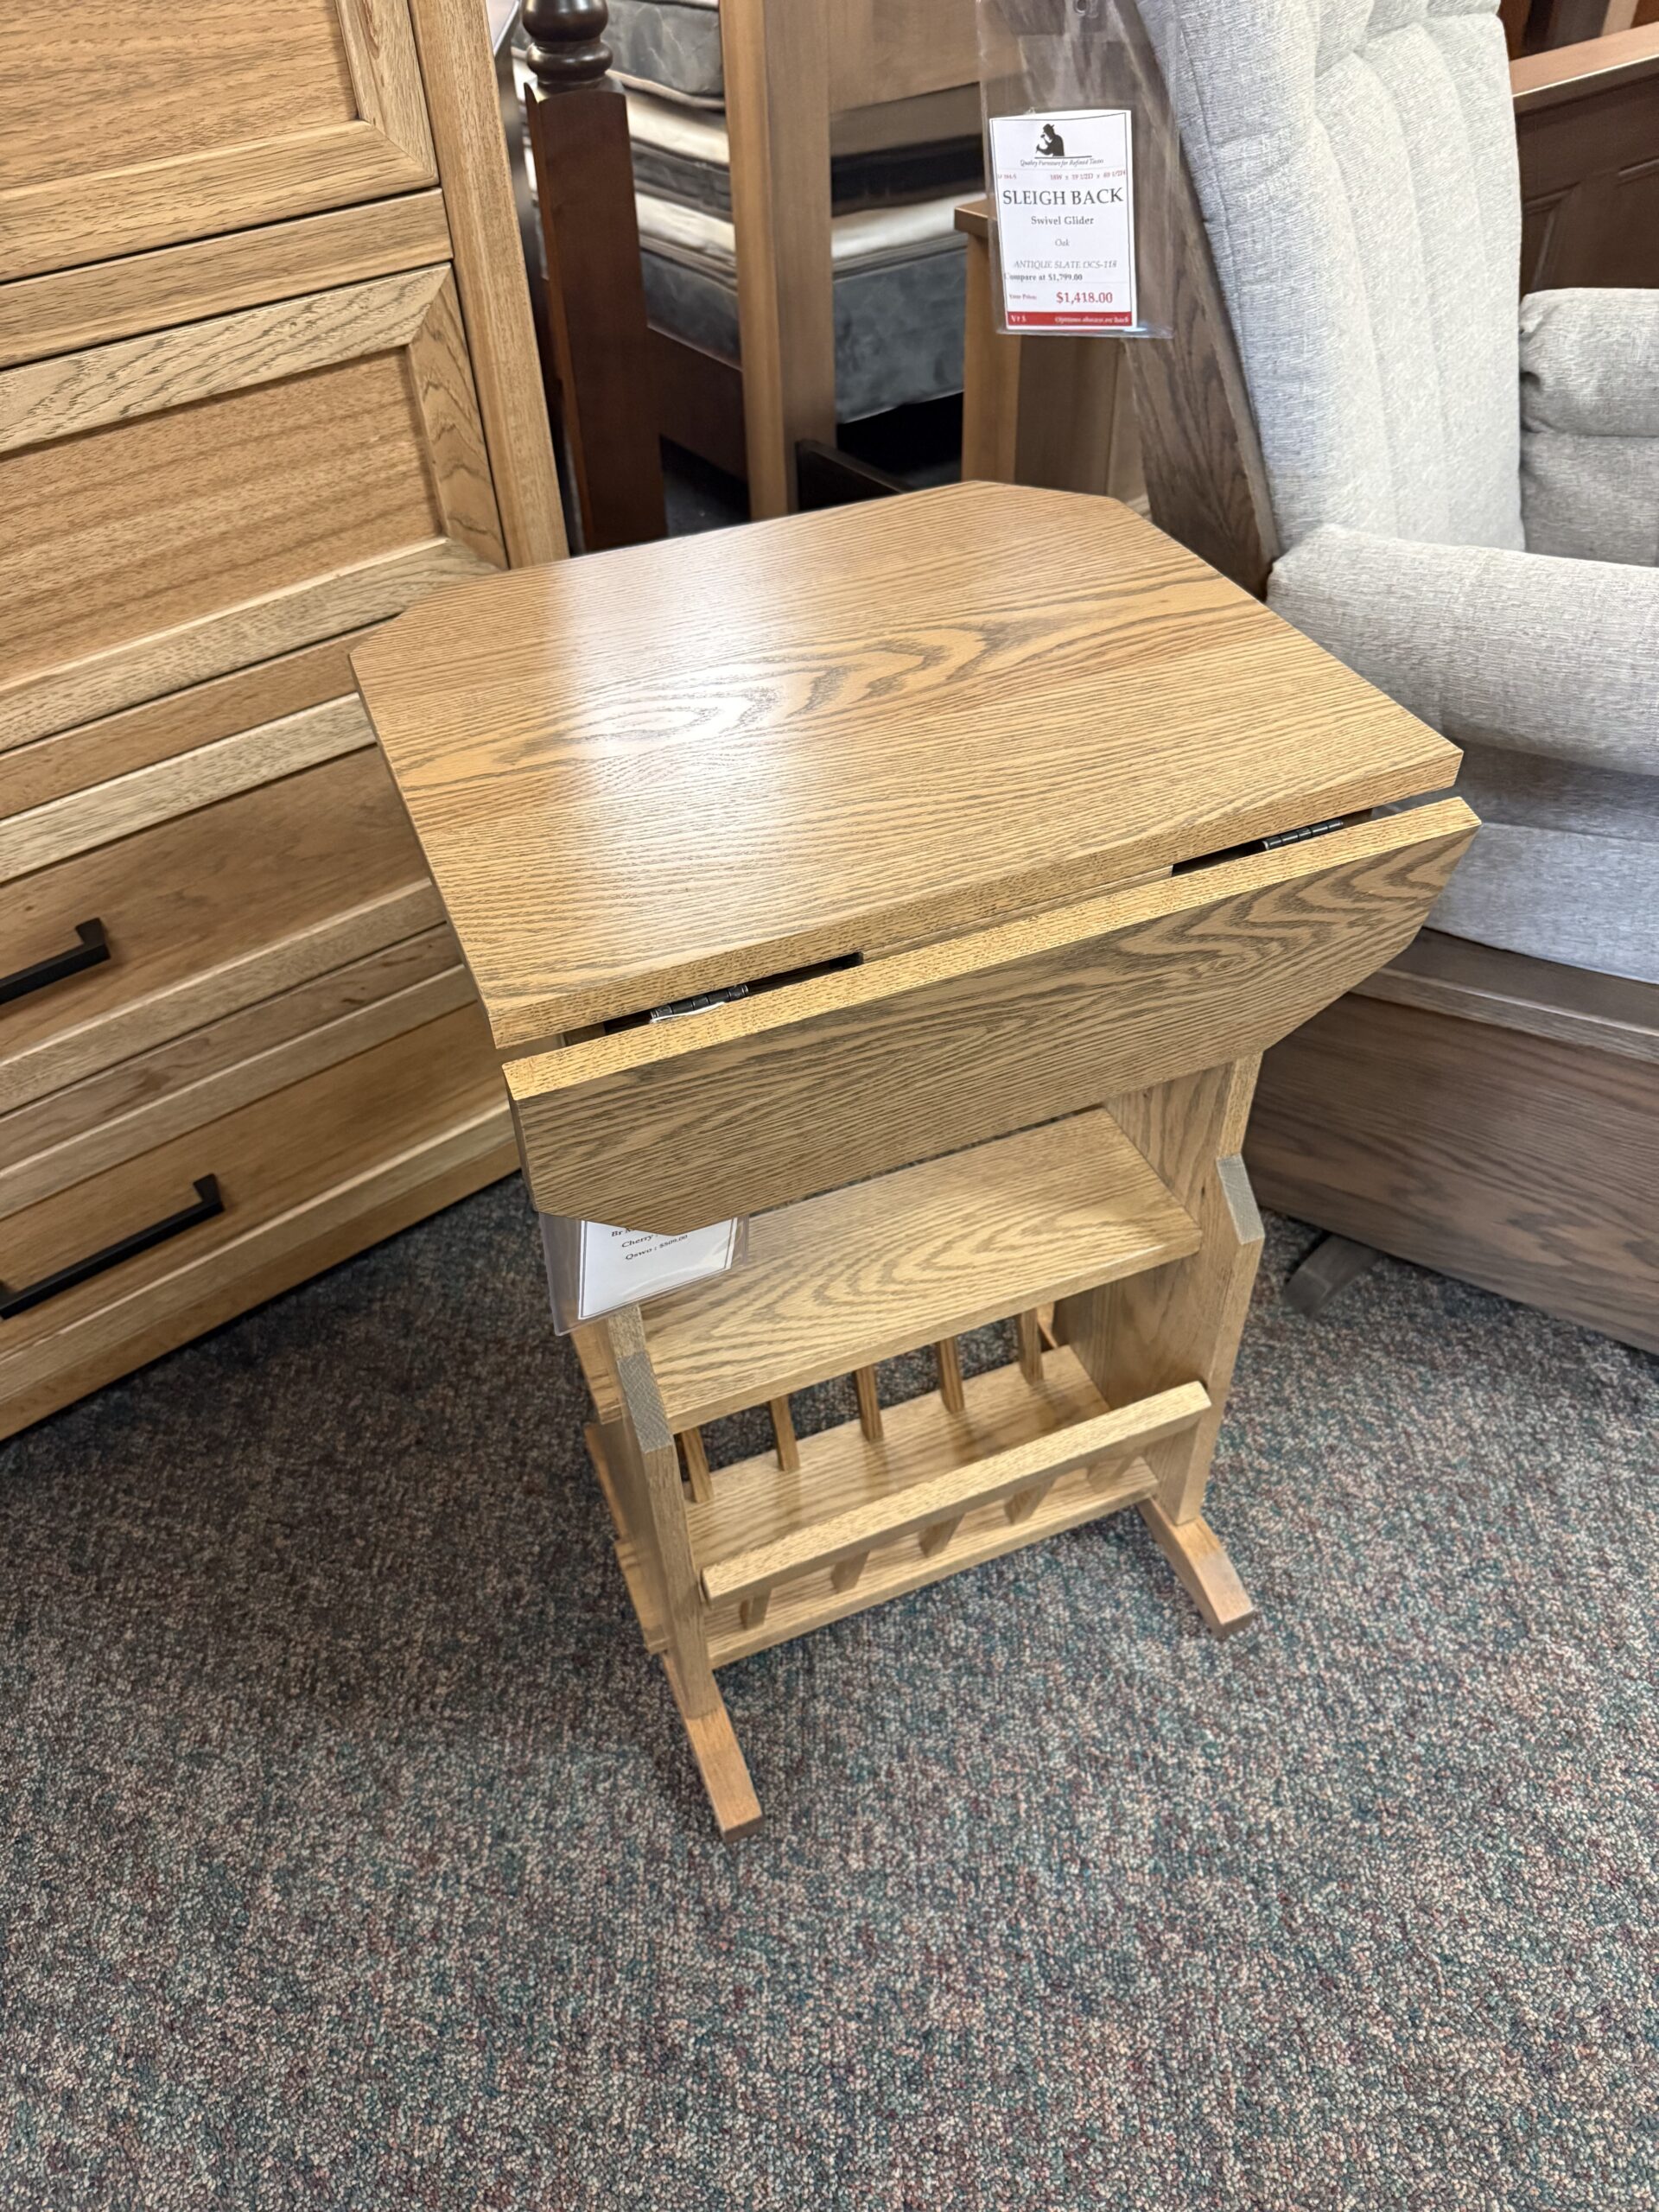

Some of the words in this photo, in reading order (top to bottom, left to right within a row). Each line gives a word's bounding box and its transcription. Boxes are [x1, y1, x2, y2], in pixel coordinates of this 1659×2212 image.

[1002, 189, 1066, 206] SLEIGH
[1071, 187, 1124, 205] BACK
[1031, 215, 1061, 226] Swivel
[1064, 214, 1094, 225] Glider
[1054, 238, 1071, 247] Oak
[1014, 260, 1052, 270] ANTIQUE
[1054, 260, 1081, 269] SLATE
[1083, 260, 1117, 269] OCS-118
[1004, 272, 1037, 283] Compare
[1048, 273, 1083, 282] $1,799.00
[1056, 292, 1113, 304] $1,418.00
[621, 1234, 653, 1248] Cherry
[625, 1248, 652, 1260] Qswo
